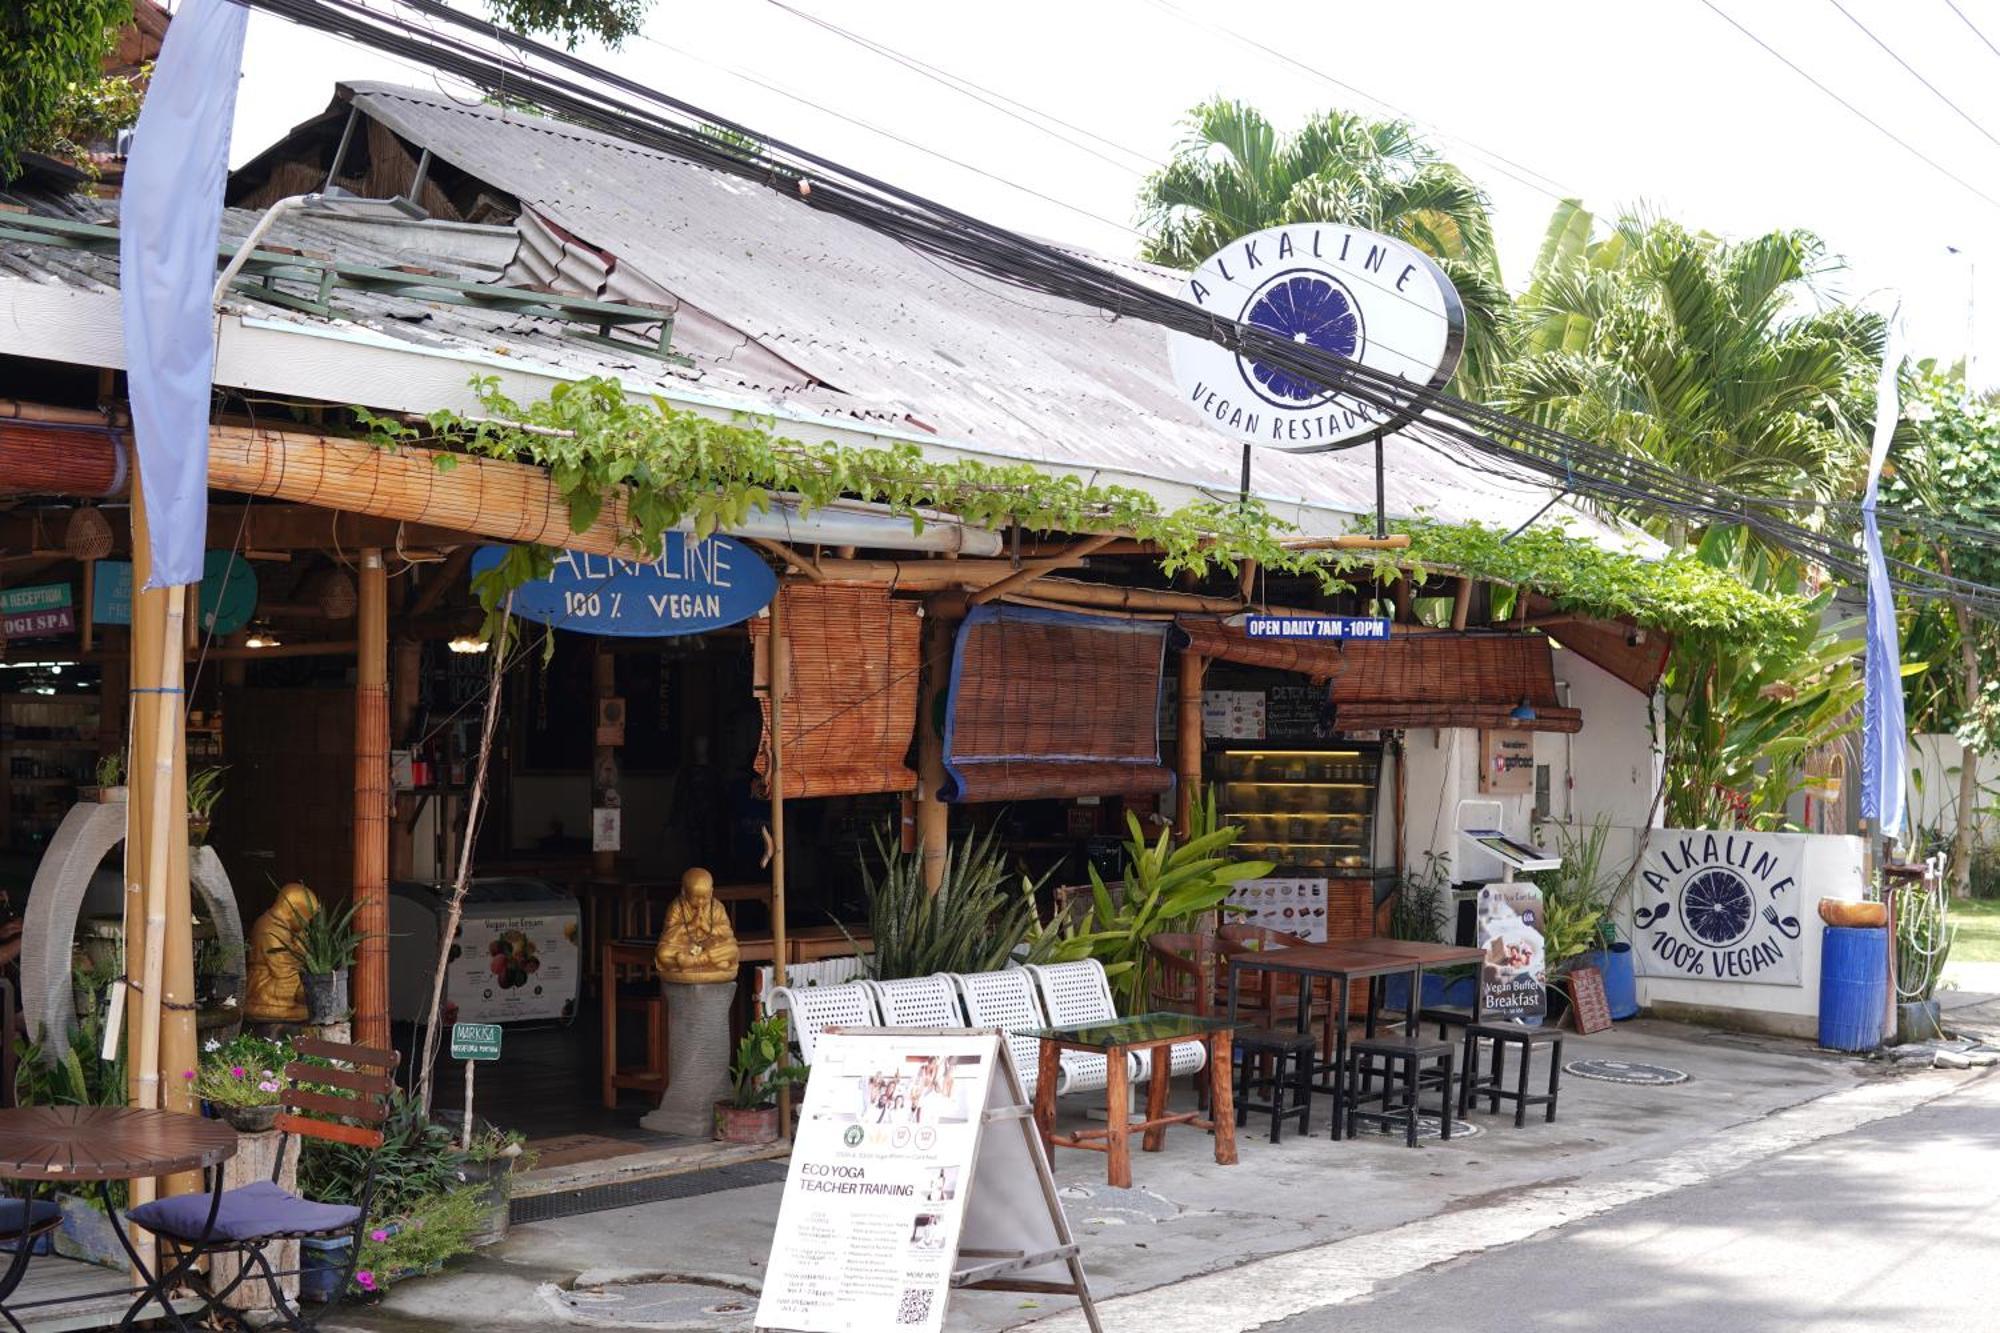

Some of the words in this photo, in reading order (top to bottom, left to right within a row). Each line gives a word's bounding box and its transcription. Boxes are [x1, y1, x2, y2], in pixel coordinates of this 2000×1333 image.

[1190, 230, 1417, 305] ALKALINE
[1192, 381, 1261, 434] VEGAN
[1272, 371, 1406, 440] RESTAUR
[548, 532, 732, 587] ALLINE
[9, 587, 63, 608] RECEPTION
[563, 591, 601, 618] 100
[647, 593, 720, 619] VEGAN
[4, 617, 33, 634] OGI
[36, 612, 69, 630] SPA
[1249, 620, 1280, 637] OPEN
[1282, 620, 1315, 637] DAILY
[1317, 620, 1343, 637] 7AM
[1642, 833, 1796, 901] ALKALINE
[1651, 930, 1705, 976] 100%
[1711, 935, 1784, 978] VEGAN
[1486, 983, 1512, 995] Vegan
[1512, 979, 1539, 992] Buffet
[1485, 995, 1540, 1008] Breakfast
[801, 1162, 829, 1178] ECO
[830, 1163, 866, 1179] YOGA
[799, 1178, 858, 1195] TEACHER
[858, 1183, 915, 1198] TRAINING
